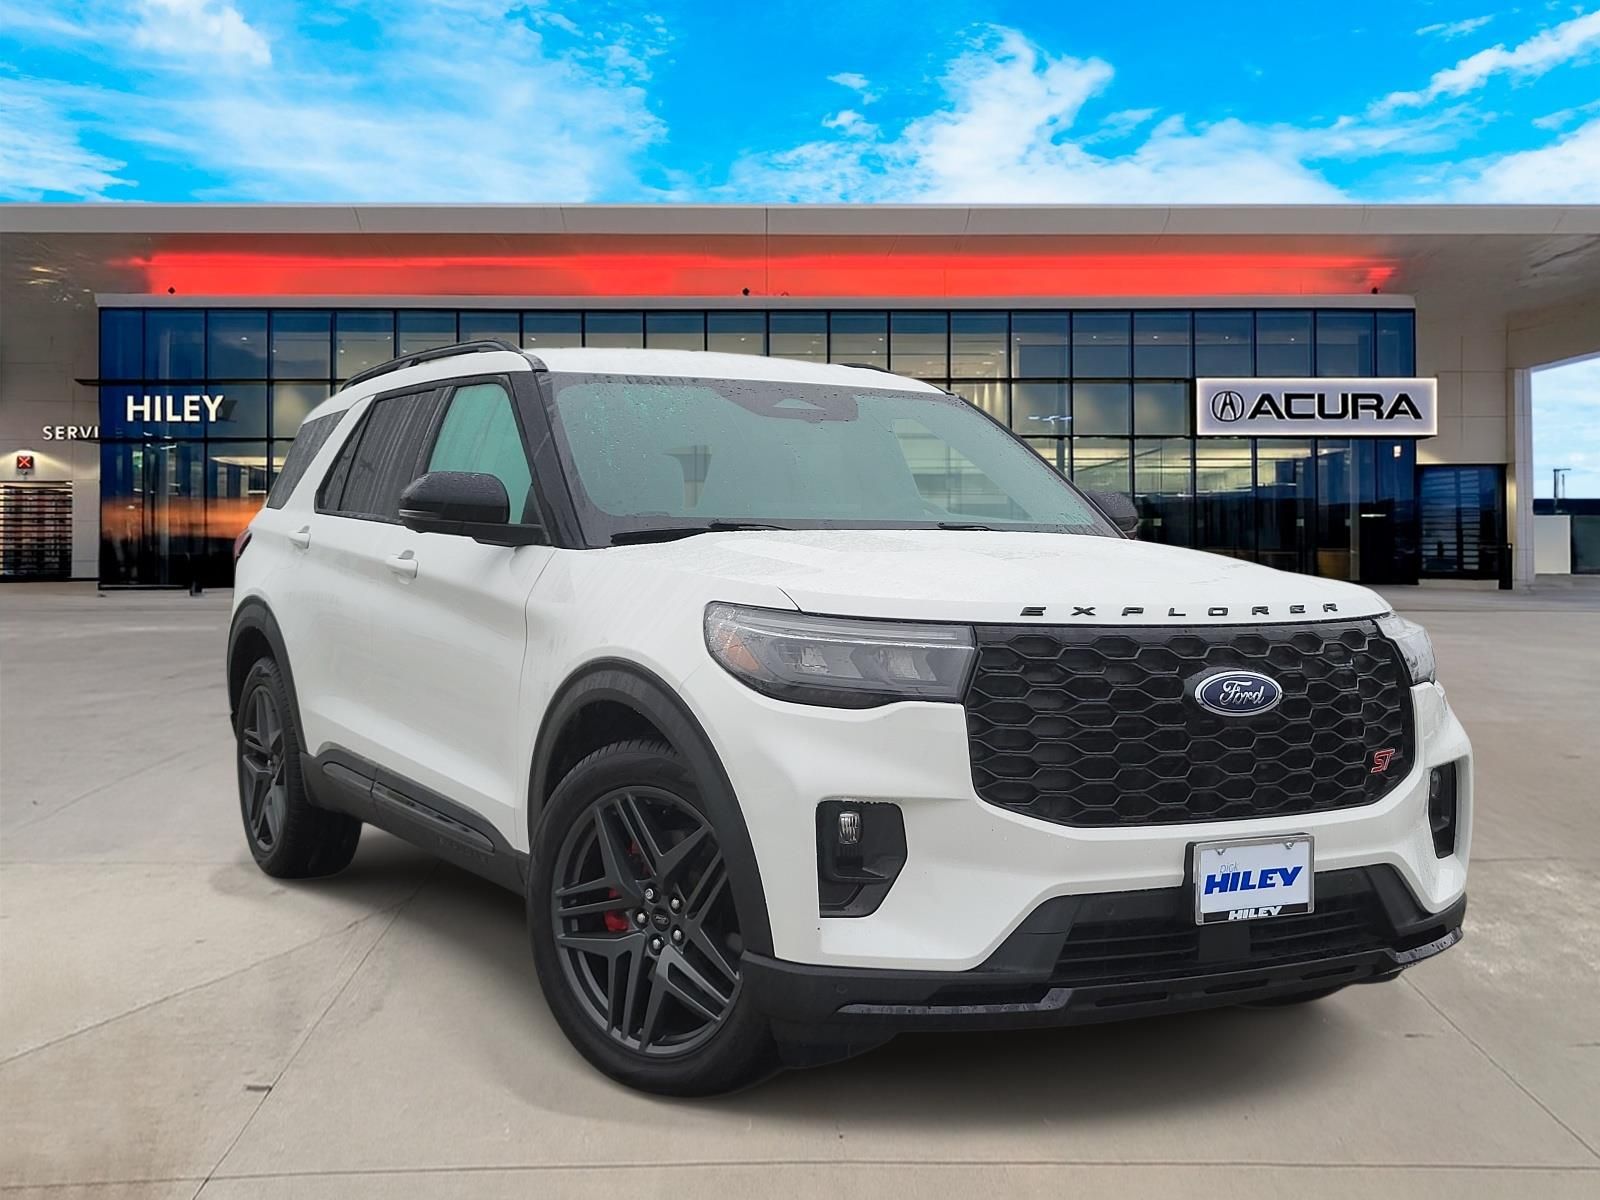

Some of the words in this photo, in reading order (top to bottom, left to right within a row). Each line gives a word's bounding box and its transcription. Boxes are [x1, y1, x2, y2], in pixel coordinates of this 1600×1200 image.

[126, 395, 224, 422] HILEY
[1248, 393, 1422, 420] ACURA
[1020, 603, 1338, 617] EXPLORER
[1219, 680, 1265, 706] Ford
[1370, 748, 1396, 774] ST
[1204, 866, 1303, 895] HILEY
[1228, 906, 1283, 921] HILEY
